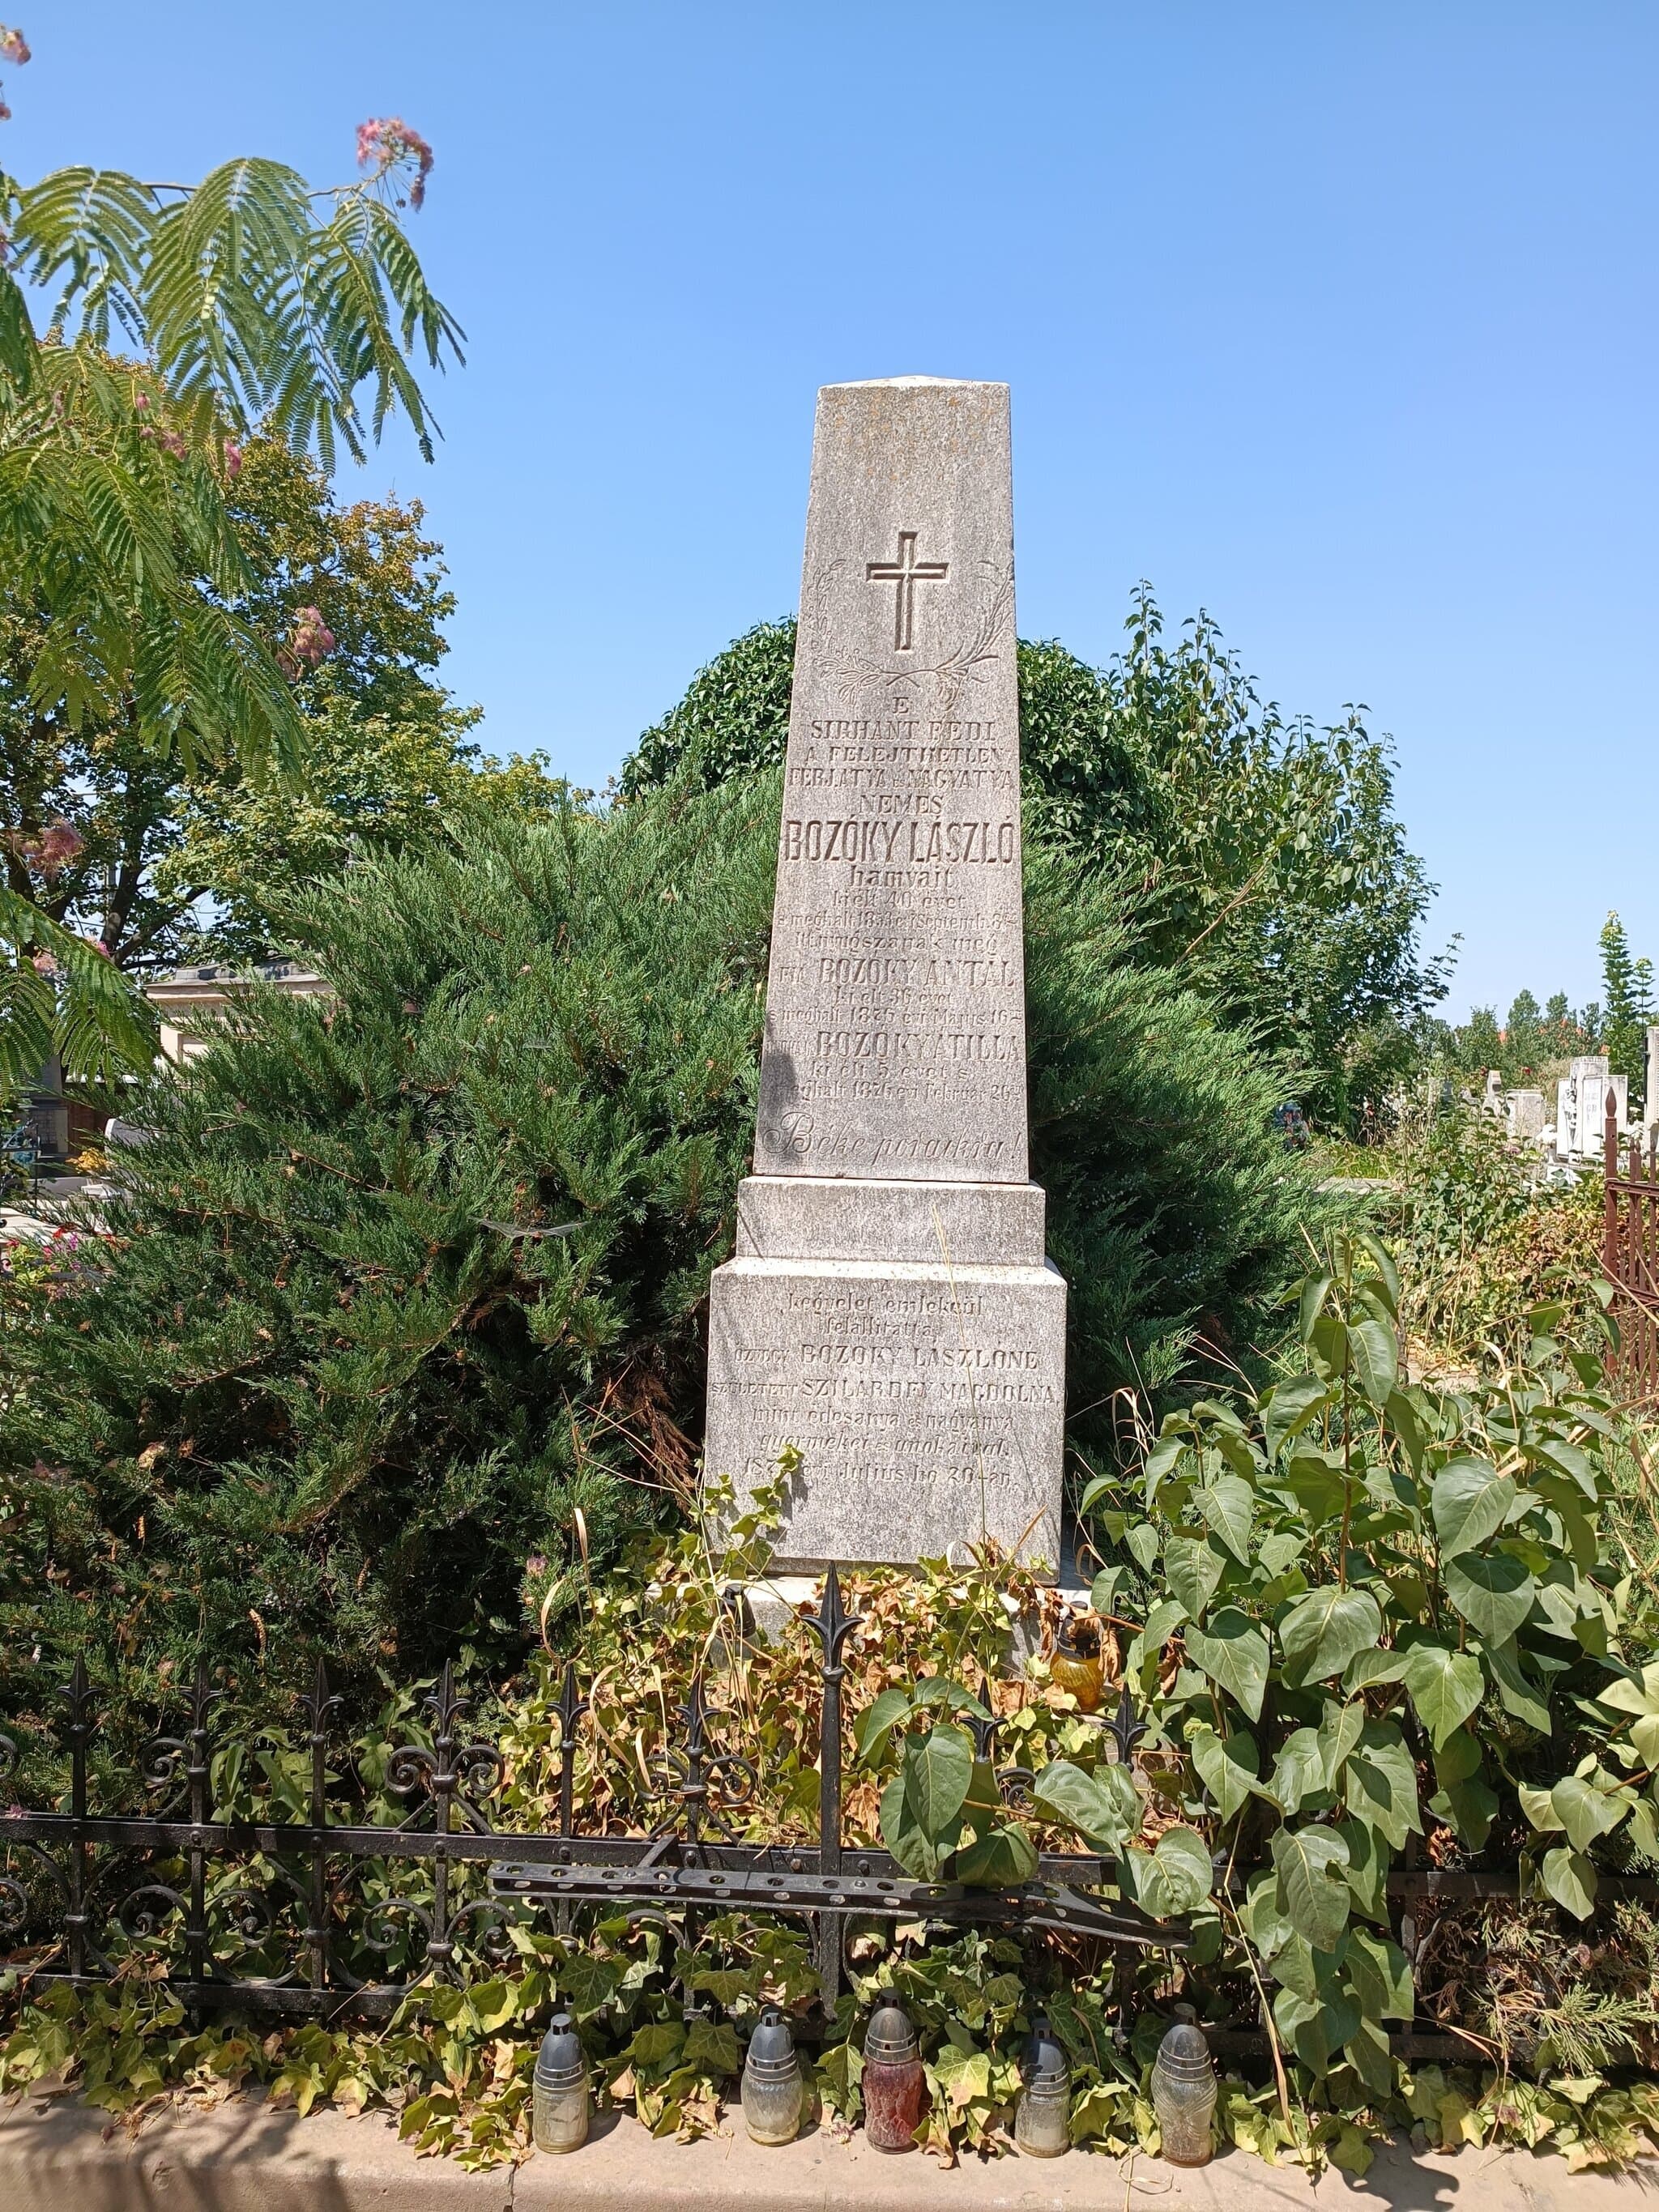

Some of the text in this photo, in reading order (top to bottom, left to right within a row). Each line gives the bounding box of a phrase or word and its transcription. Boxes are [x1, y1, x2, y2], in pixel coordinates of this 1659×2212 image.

[892, 697, 910, 714] E
[805, 746, 817, 764] A
[908, 769, 1013, 790] NAGYATYA
[859, 794, 944, 815] NEMES
[784, 814, 1015, 864] BOZÓKY LÁSZLÓ
[744, 1456, 789, 1477] 187
